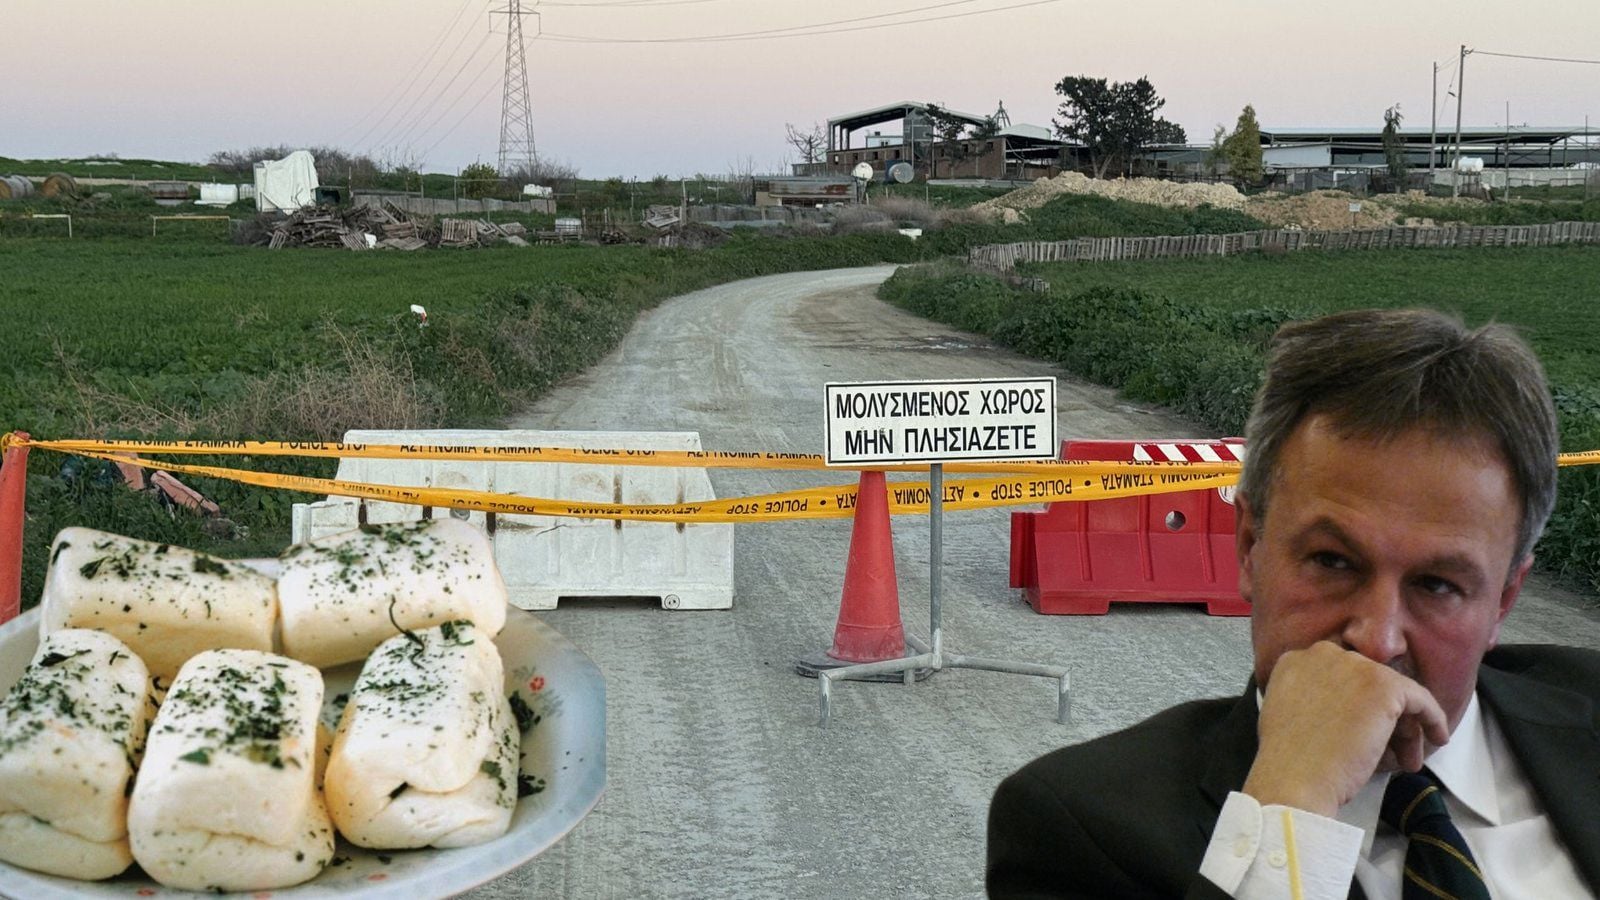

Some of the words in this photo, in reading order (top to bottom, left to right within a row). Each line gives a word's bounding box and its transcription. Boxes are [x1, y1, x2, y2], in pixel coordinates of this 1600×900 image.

[836, 390, 970, 419] ΜΟΛΥΣΜΕΝΟΣ
[980, 388, 1046, 415] ΧΩΡΟΣ
[845, 429, 893, 455] ΜΗΝ
[904, 425, 1036, 453] ΠΛΗΣΙΑΖΕΤΕ
[893, 485, 965, 505] ΑΣΤΝΟΜΙΑ
[991, 482, 1023, 500] STOP
[1029, 478, 1072, 498] POLICE
[726, 502, 759, 514] STOP
[765, 498, 808, 513] POLICE
